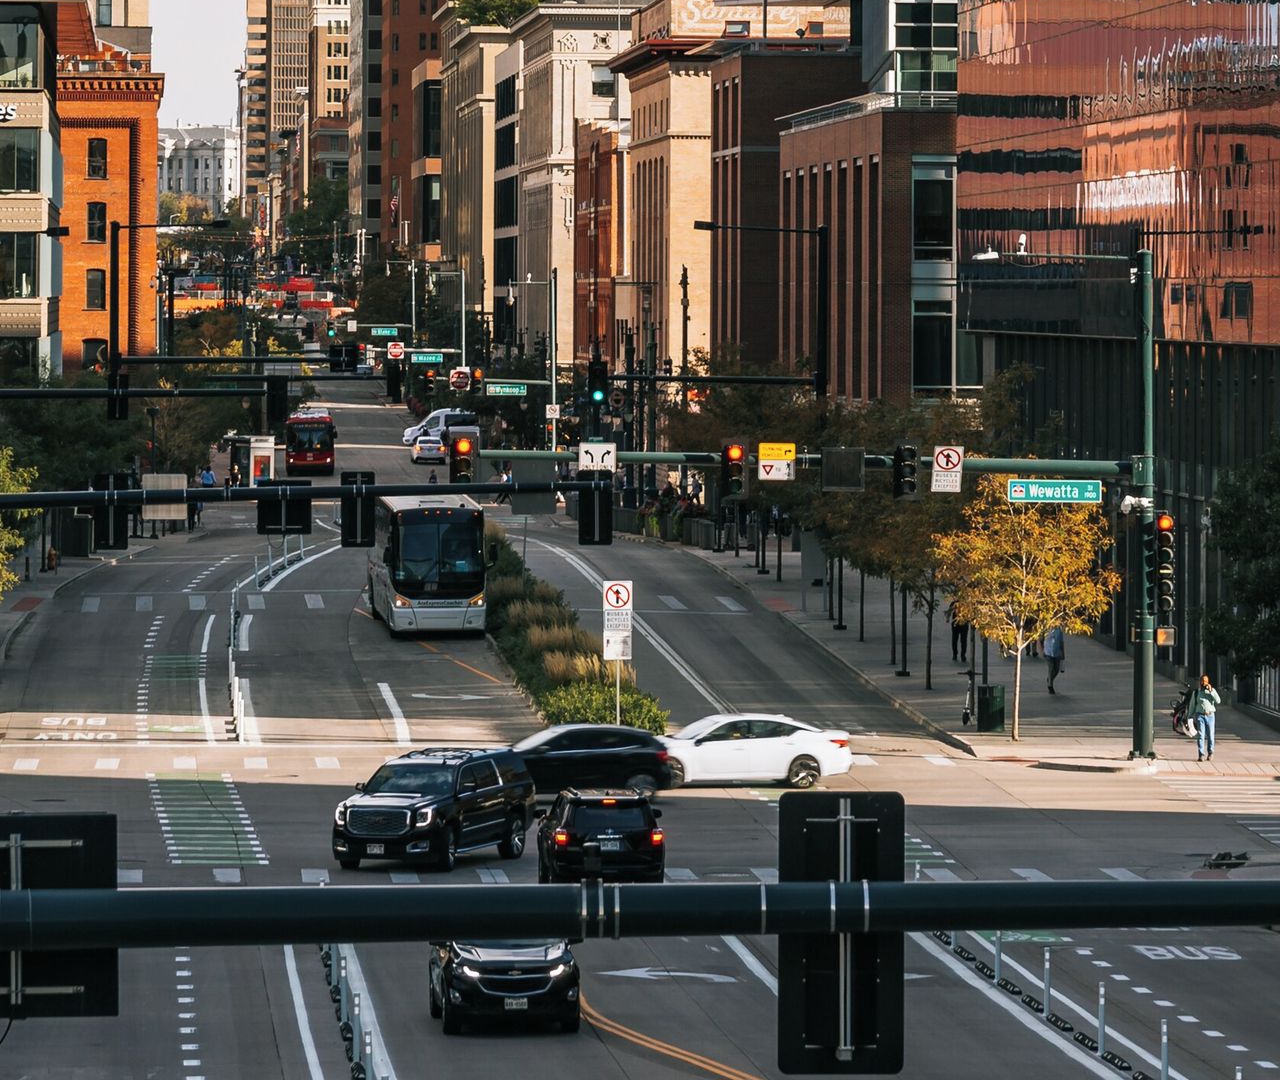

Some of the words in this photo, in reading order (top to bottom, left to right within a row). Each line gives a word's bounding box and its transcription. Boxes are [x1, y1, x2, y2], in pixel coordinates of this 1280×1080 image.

[495, 387, 520, 395] Wynkoop
[1029, 483, 1079, 498] Wewatta
[41, 717, 107, 726] BUS
[1129, 944, 1242, 960] BUS
